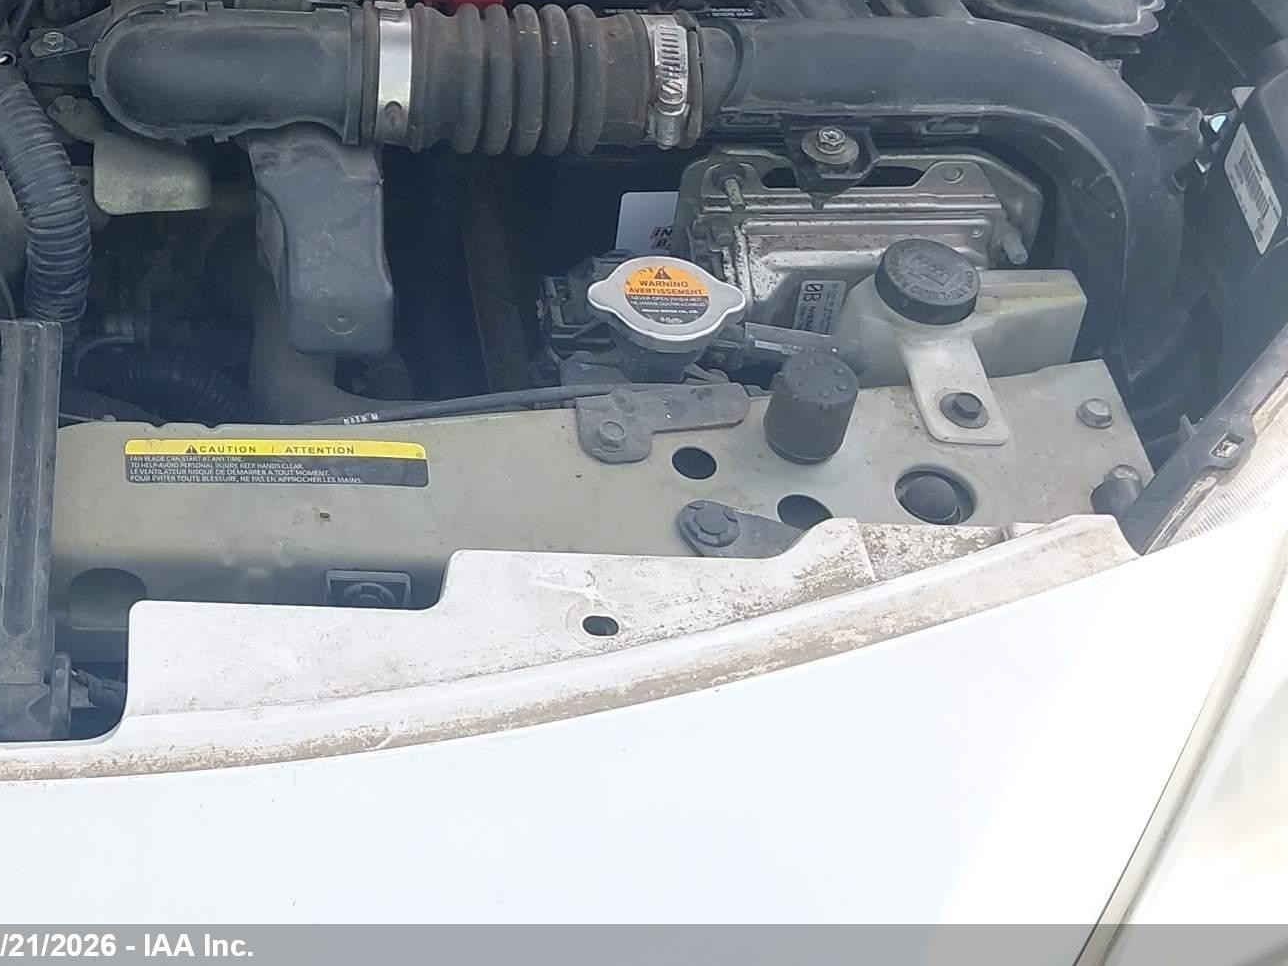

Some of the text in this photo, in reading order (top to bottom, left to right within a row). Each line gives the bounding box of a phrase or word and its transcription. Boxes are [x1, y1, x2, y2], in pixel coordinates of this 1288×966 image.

[199, 445, 256, 454] CAUTION
[284, 445, 355, 455] ATTENTION
[187, 468, 213, 476] RISQUE
